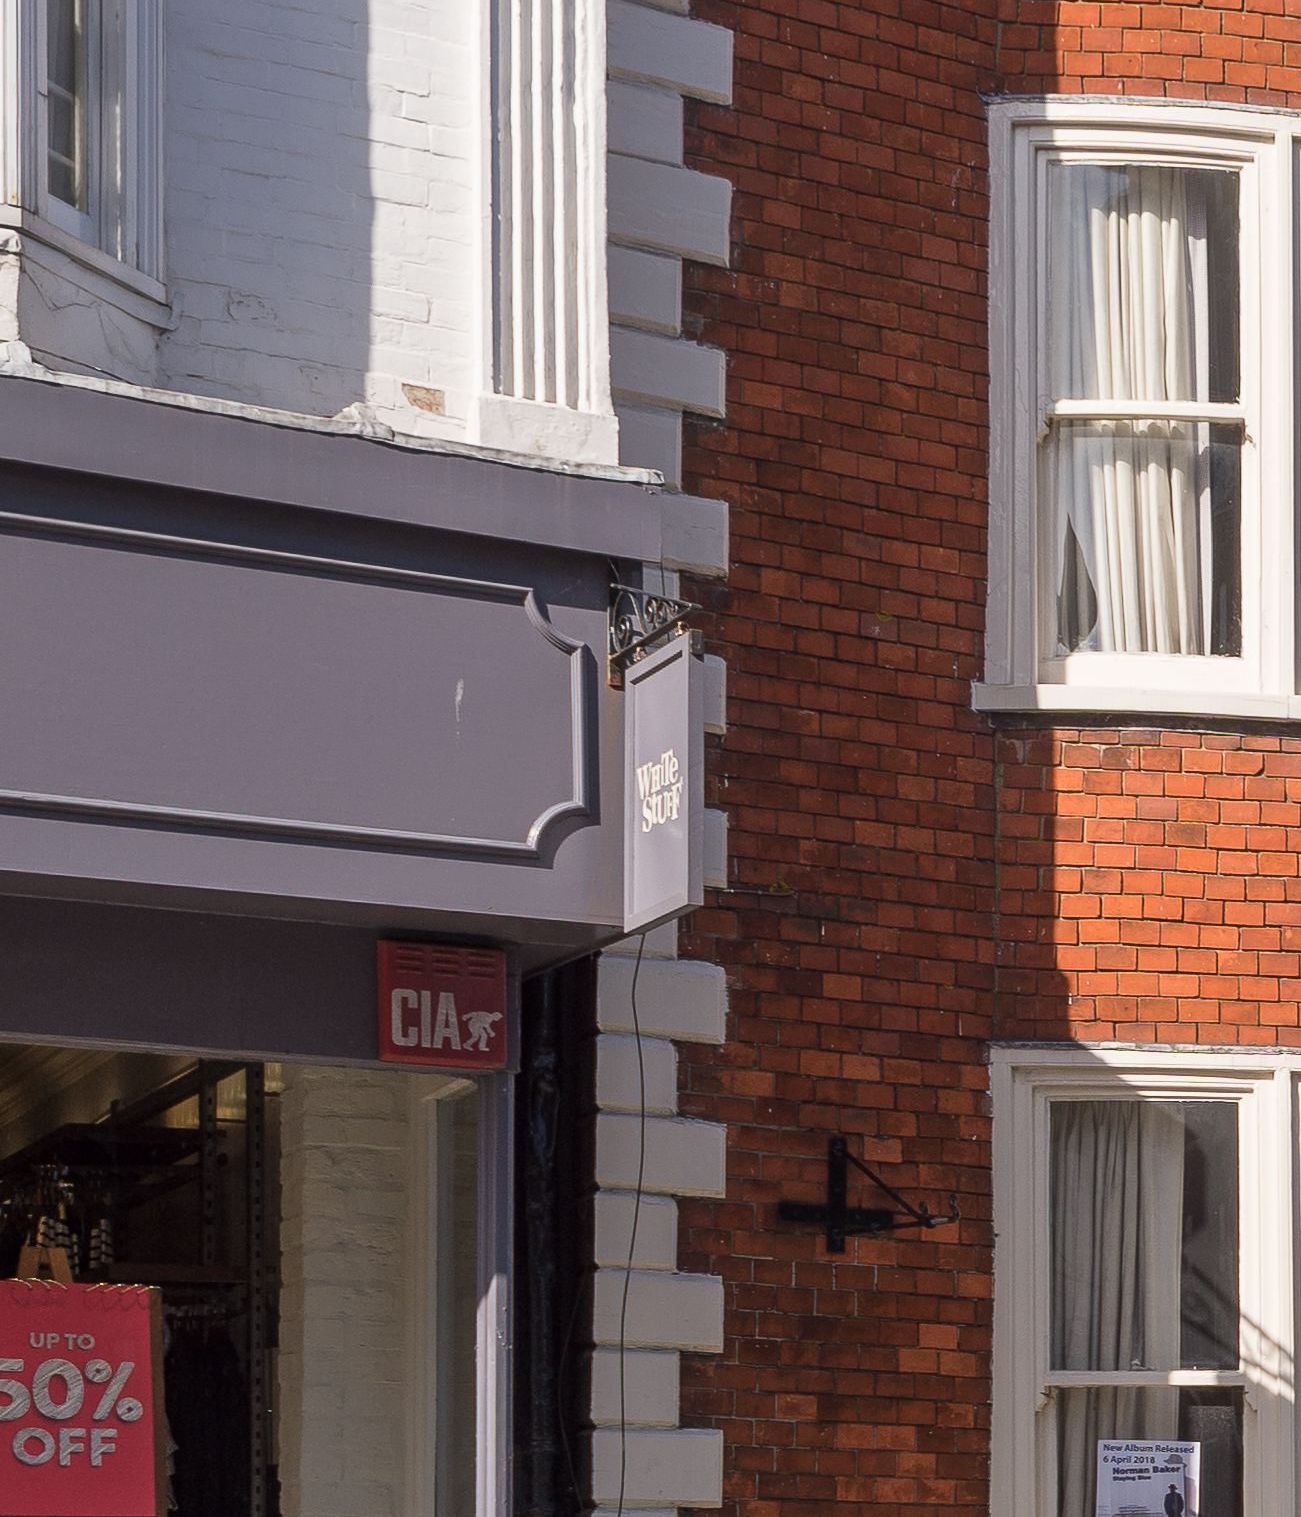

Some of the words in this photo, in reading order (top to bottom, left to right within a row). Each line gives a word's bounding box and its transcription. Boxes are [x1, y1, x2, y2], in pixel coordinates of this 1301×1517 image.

[391, 988, 462, 1050] CIA
[29, 1332, 60, 1350] UP
[64, 1333, 96, 1351] TO
[0, 1358, 144, 1422] 50%
[12, 1427, 118, 1467] OFF
[1103, 1443, 1123, 1452] New
[1124, 1444, 1153, 1452] Album
[1155, 1445, 1195, 1454] Released
[1110, 1455, 1132, 1465] April
[1133, 1456, 1156, 1464] 2018
[1112, 1467, 1150, 1475] Norman
